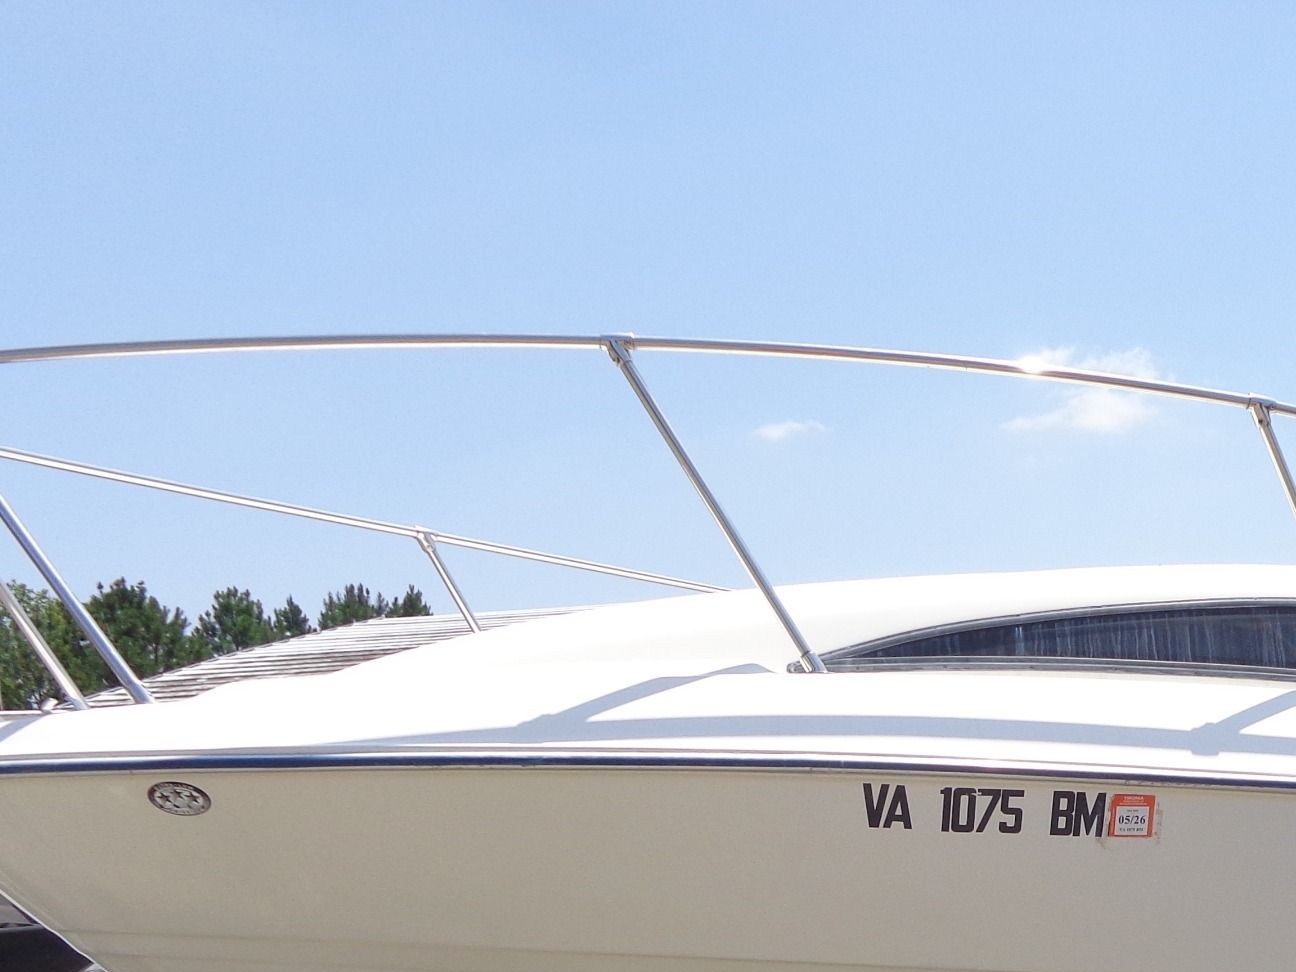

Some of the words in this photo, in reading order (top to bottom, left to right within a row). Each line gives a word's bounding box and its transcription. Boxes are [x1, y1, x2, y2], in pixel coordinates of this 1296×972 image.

[862, 782, 913, 830] VA
[940, 786, 1025, 834] 1075
[1049, 790, 1107, 838] BM
[1118, 814, 1146, 825] 05/26
